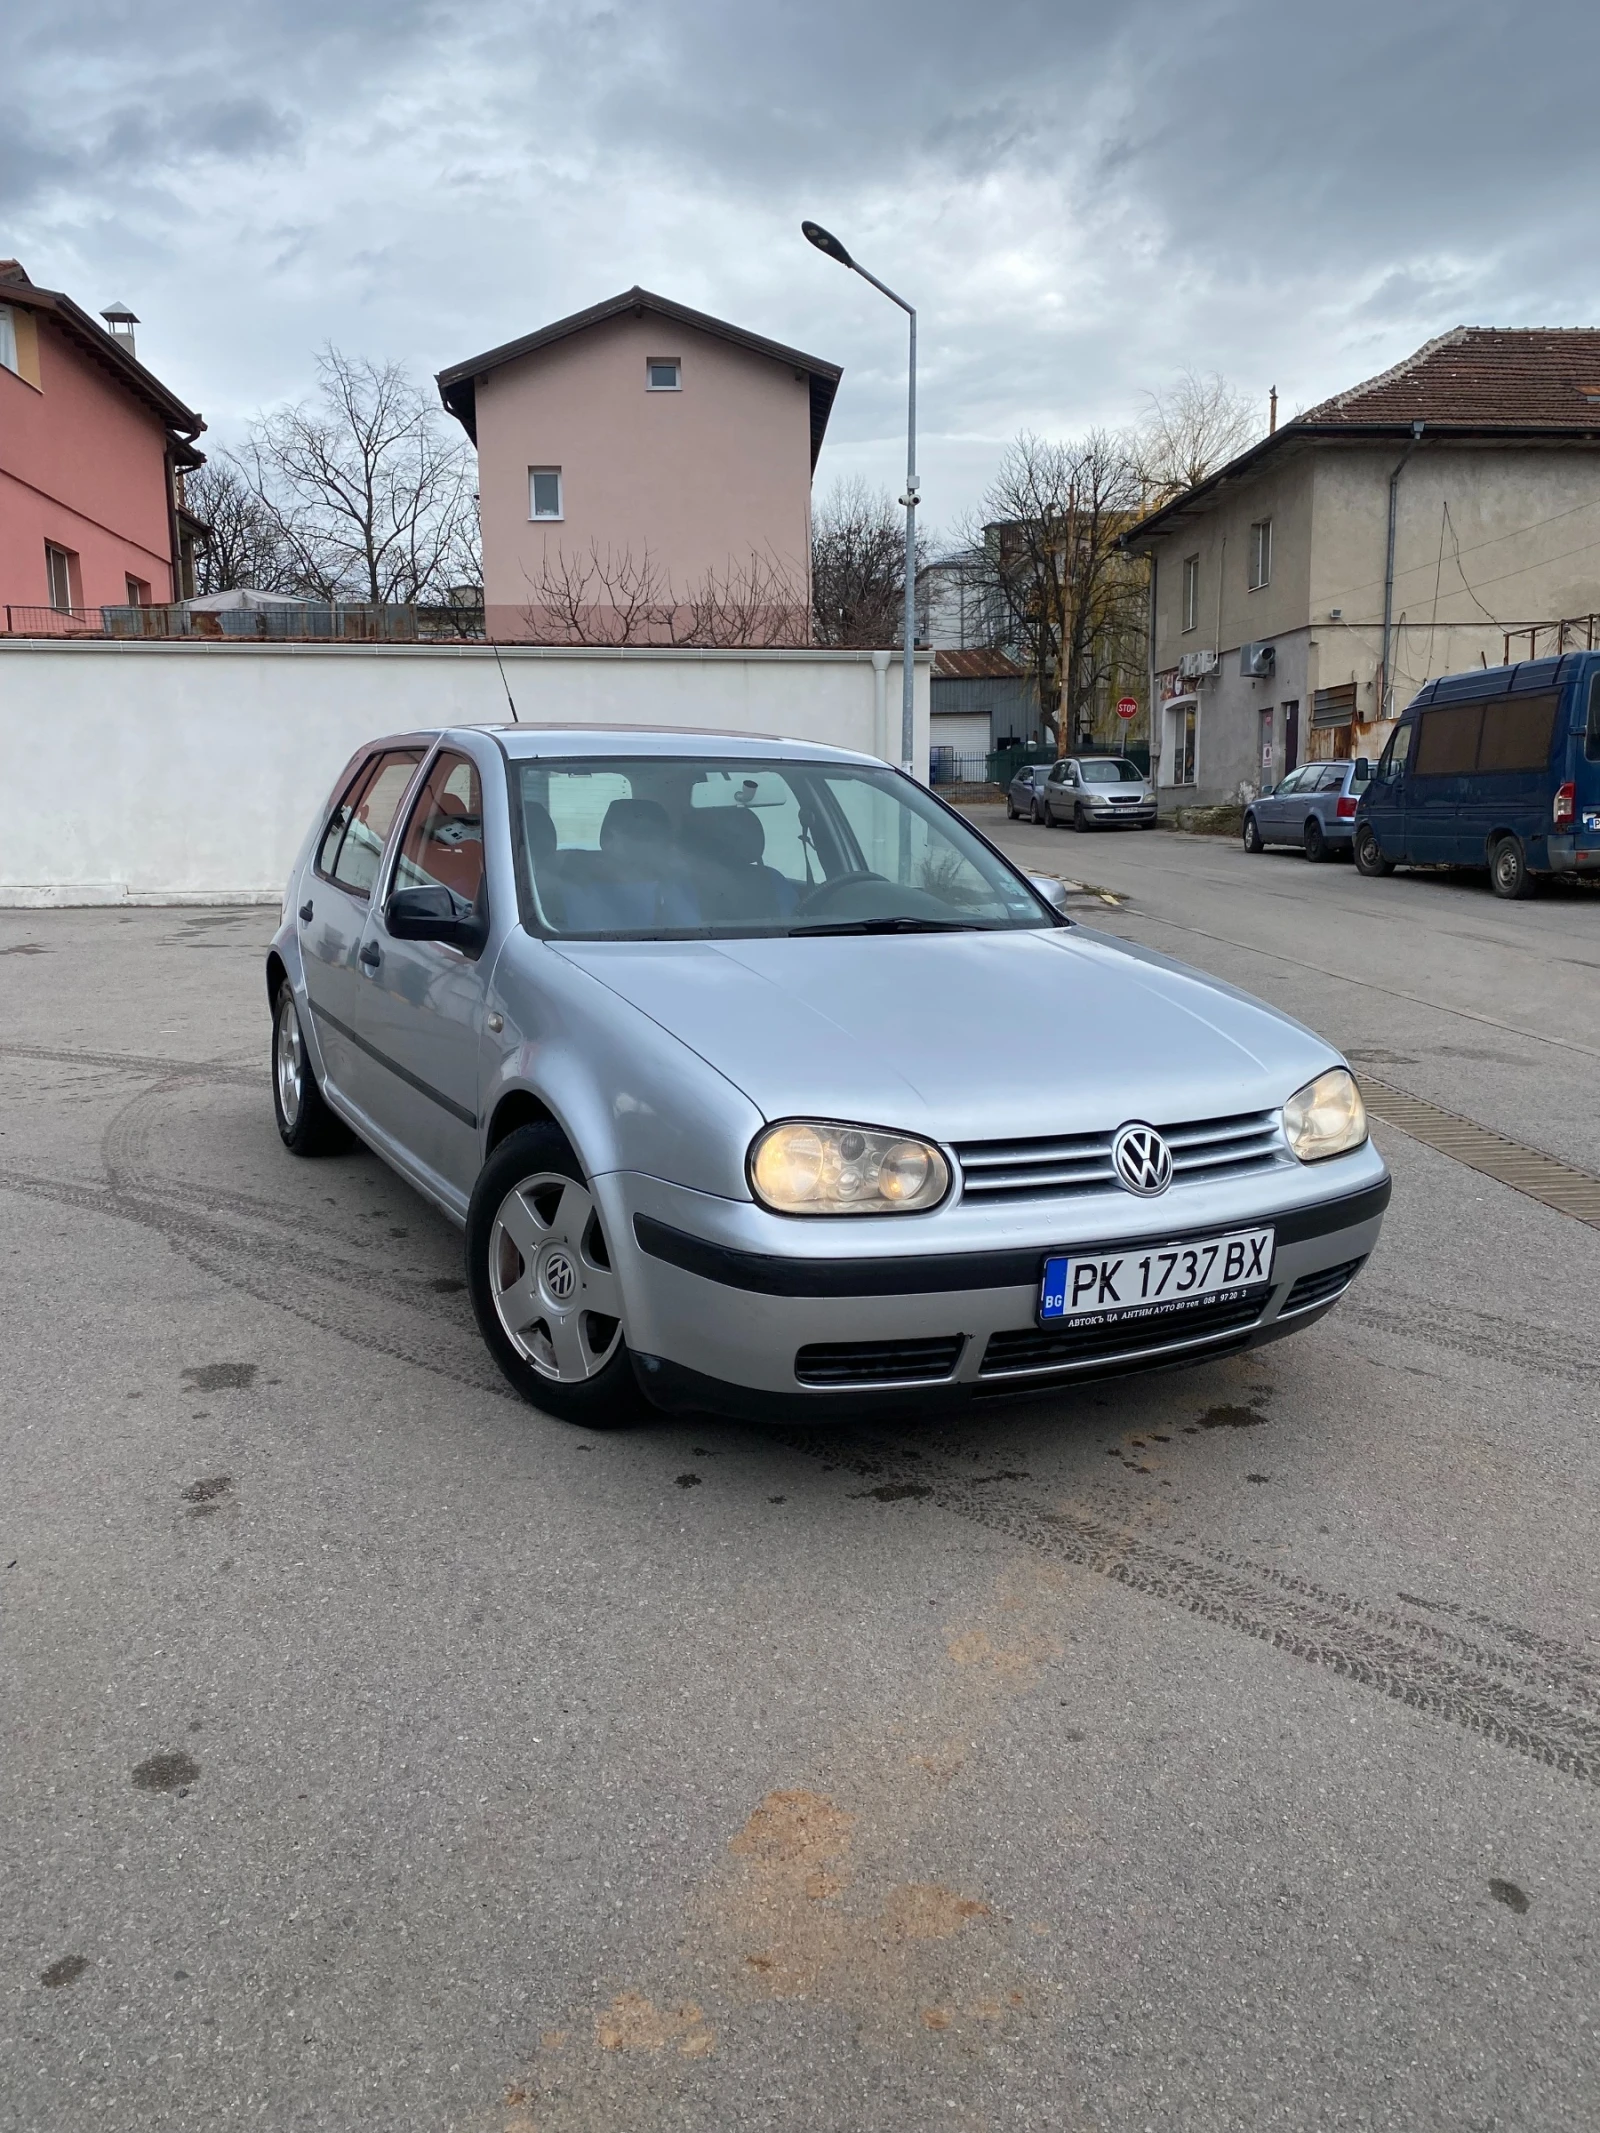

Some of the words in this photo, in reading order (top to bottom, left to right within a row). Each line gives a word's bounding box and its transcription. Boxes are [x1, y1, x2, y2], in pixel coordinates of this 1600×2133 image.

[1118, 704, 1136, 713] STOP
[1071, 1259, 1124, 1307] PK
[1138, 1244, 1220, 1297] 1737
[1222, 1235, 1268, 1283] BX
[1045, 1294, 1062, 1308] BG
